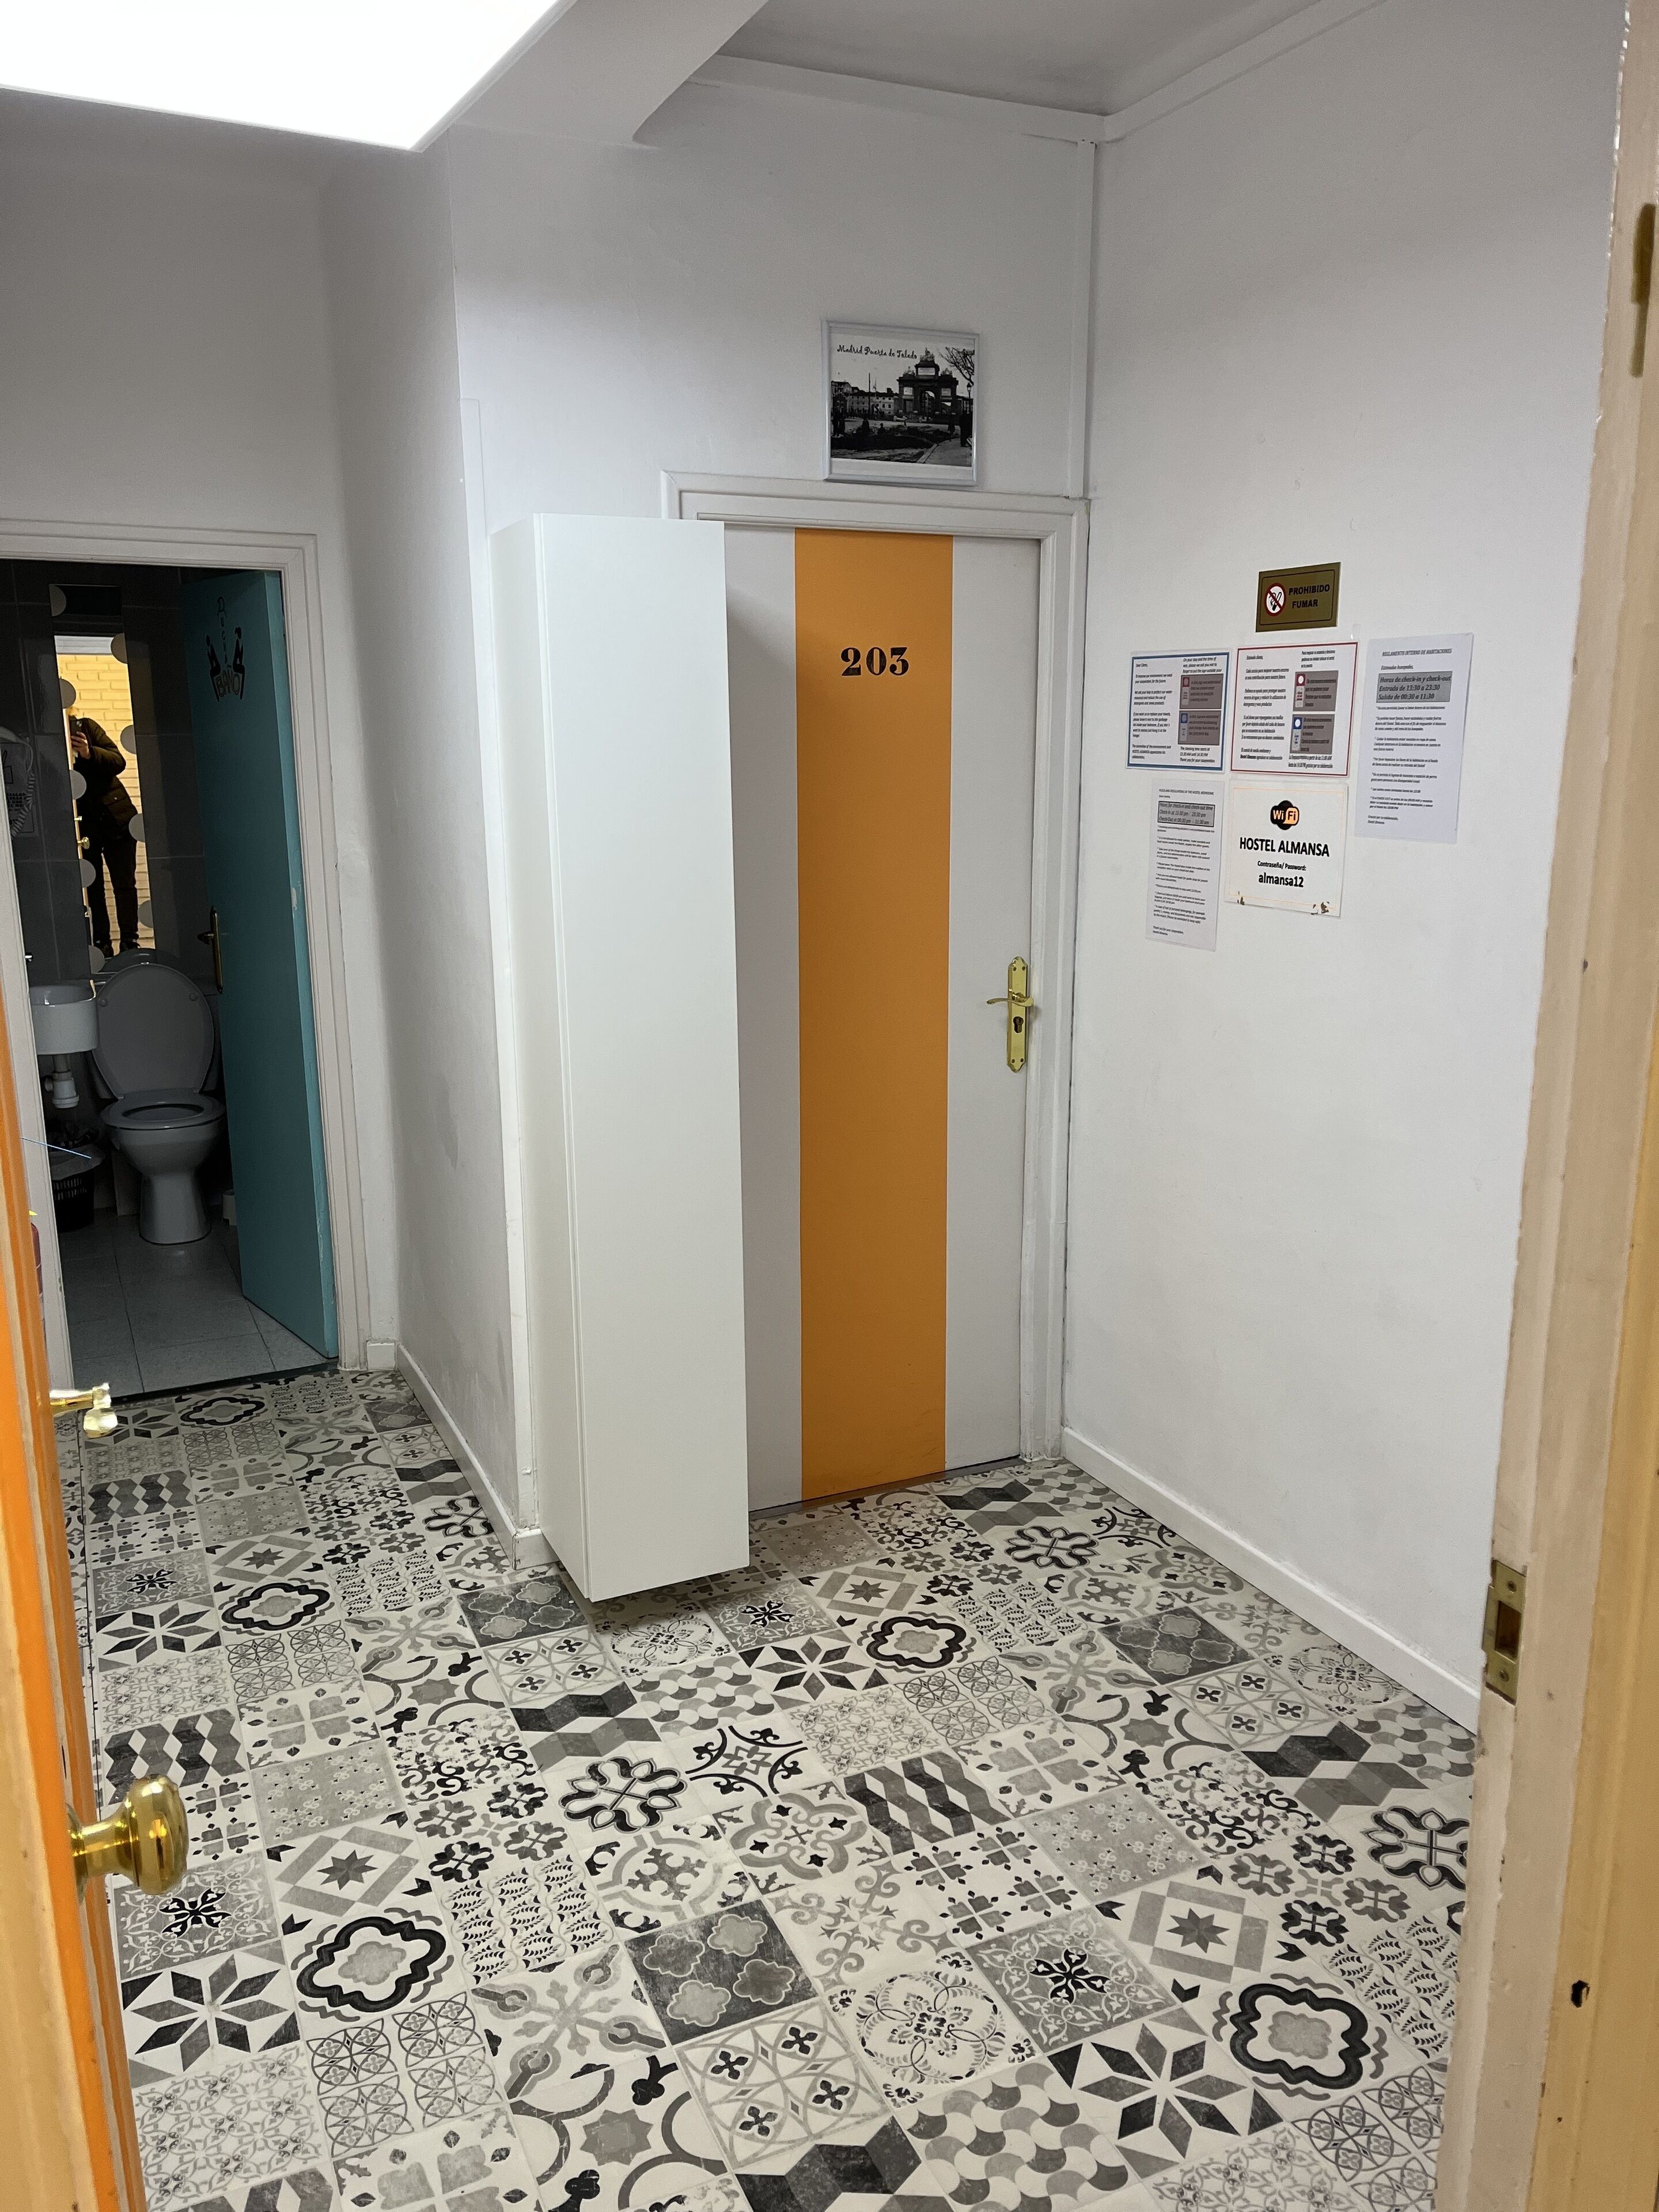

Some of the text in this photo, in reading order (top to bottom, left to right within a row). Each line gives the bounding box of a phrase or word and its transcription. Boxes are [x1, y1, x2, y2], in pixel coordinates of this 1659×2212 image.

[837, 344, 917, 359] Madrid Puerta de Toledo
[1289, 584, 1330, 596] PROHIBIDO
[1292, 600, 1318, 608] FUMAR
[841, 647, 909, 676] 203
[1240, 837, 1330, 857] HOSTEL ALMANSA
[1257, 861, 1285, 870] Contraseña/
[1259, 872, 1304, 888] almansa12
